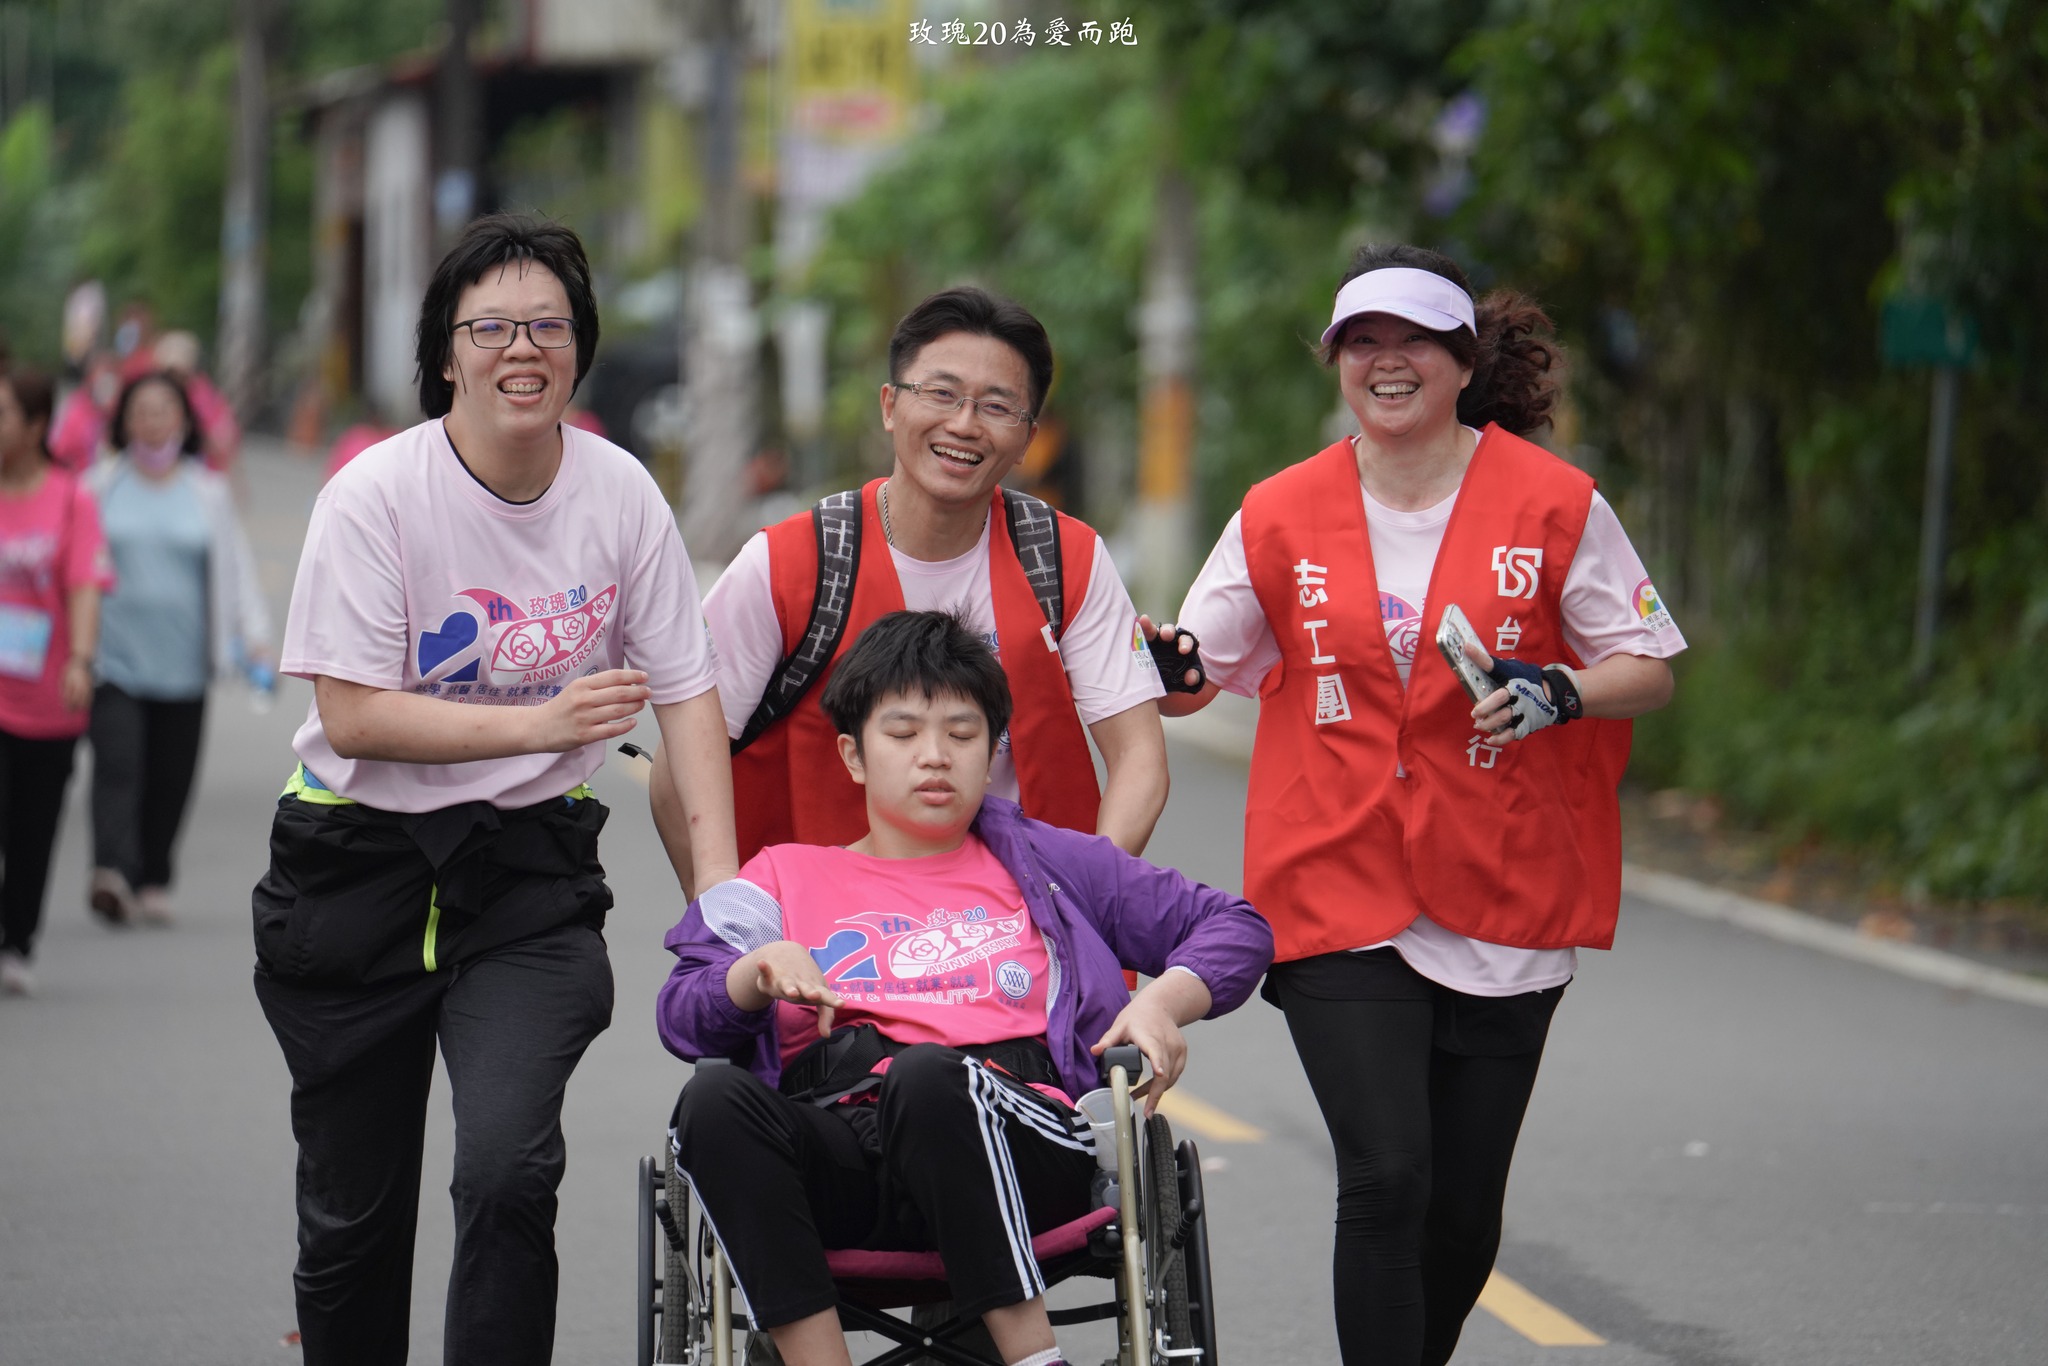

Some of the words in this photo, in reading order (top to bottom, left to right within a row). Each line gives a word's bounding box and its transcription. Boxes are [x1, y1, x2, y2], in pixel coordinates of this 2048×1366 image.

[529, 584, 588, 617] 玫瑰20
[521, 622, 608, 684] ANNIVERSARY
[1293, 558, 1352, 726] 志工團
[833, 991, 862, 1003] VE
[885, 987, 979, 1005] EQUALITY
